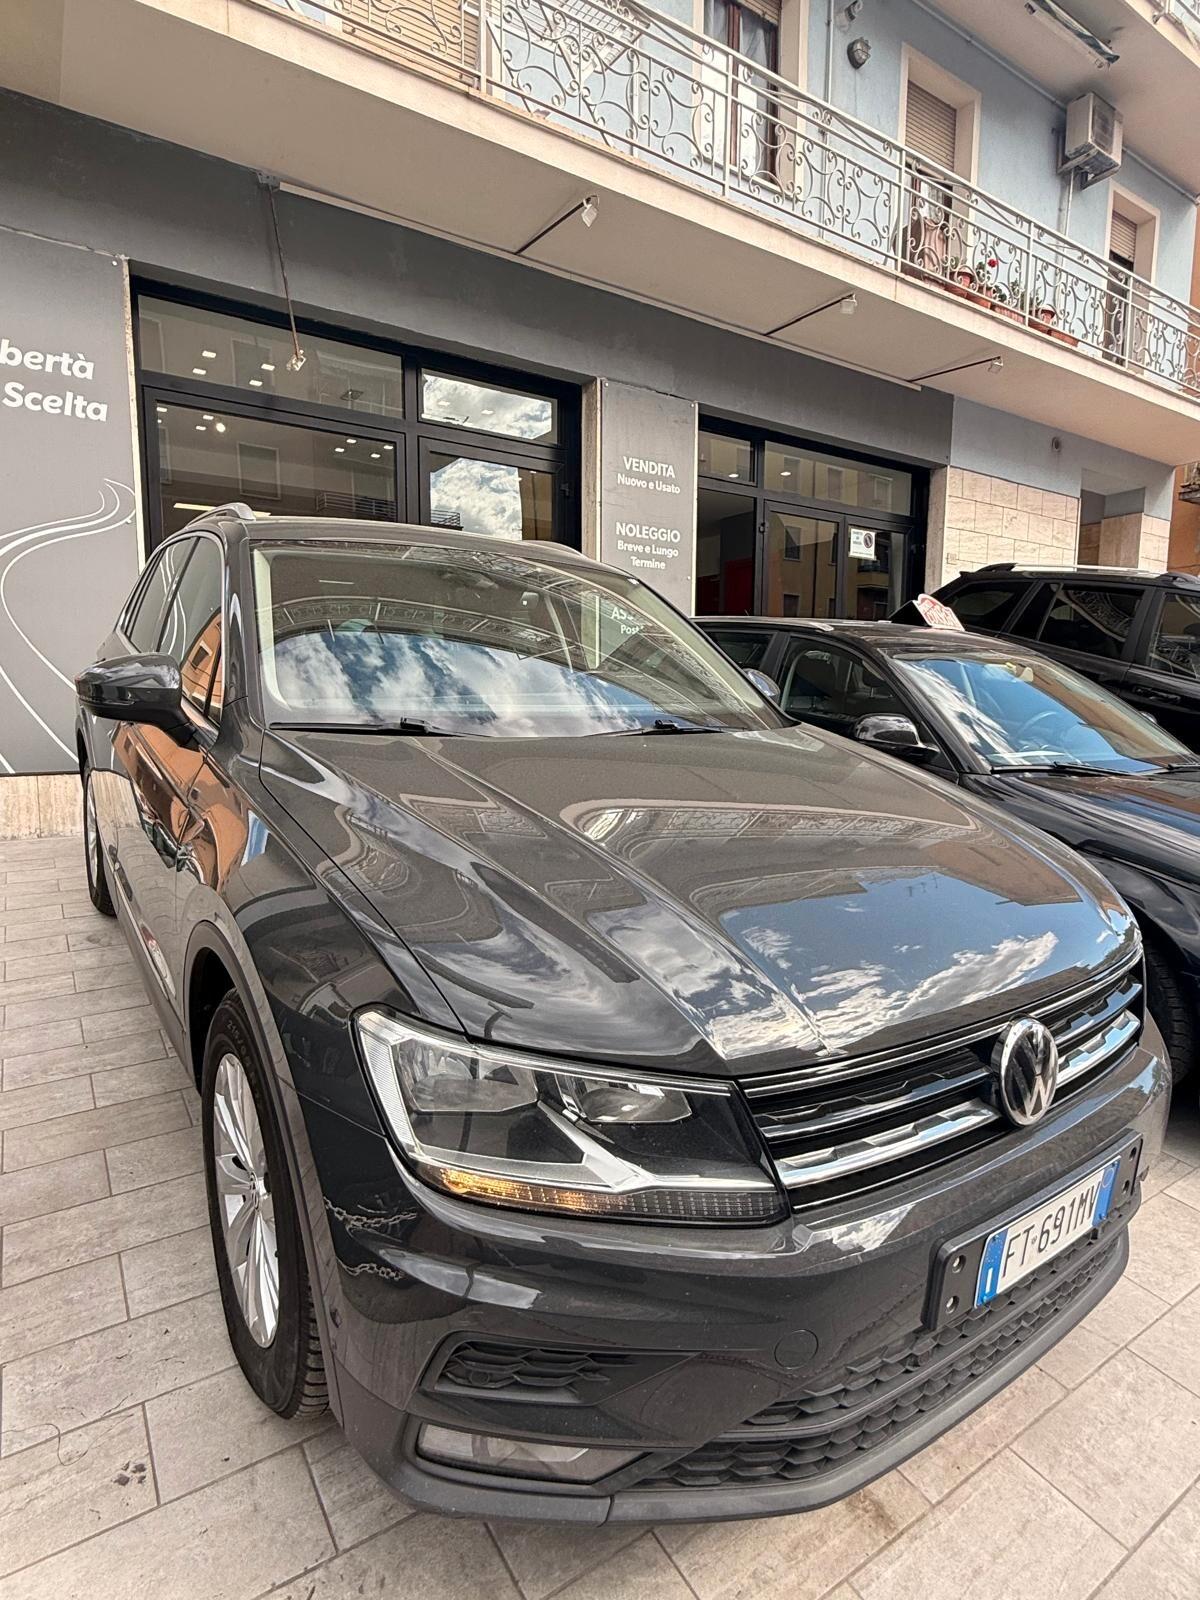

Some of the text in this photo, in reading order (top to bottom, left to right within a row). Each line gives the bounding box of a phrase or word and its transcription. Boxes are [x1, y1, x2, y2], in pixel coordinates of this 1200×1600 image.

[2, 381, 108, 422] Scelta
[623, 455, 676, 479] VENDITA
[617, 473, 681, 494] Nuovo e Usato
[615, 521, 681, 543] NOLEGGIO
[617, 540, 679, 558] Breve e Lungo
[630, 556, 666, 570] Termine
